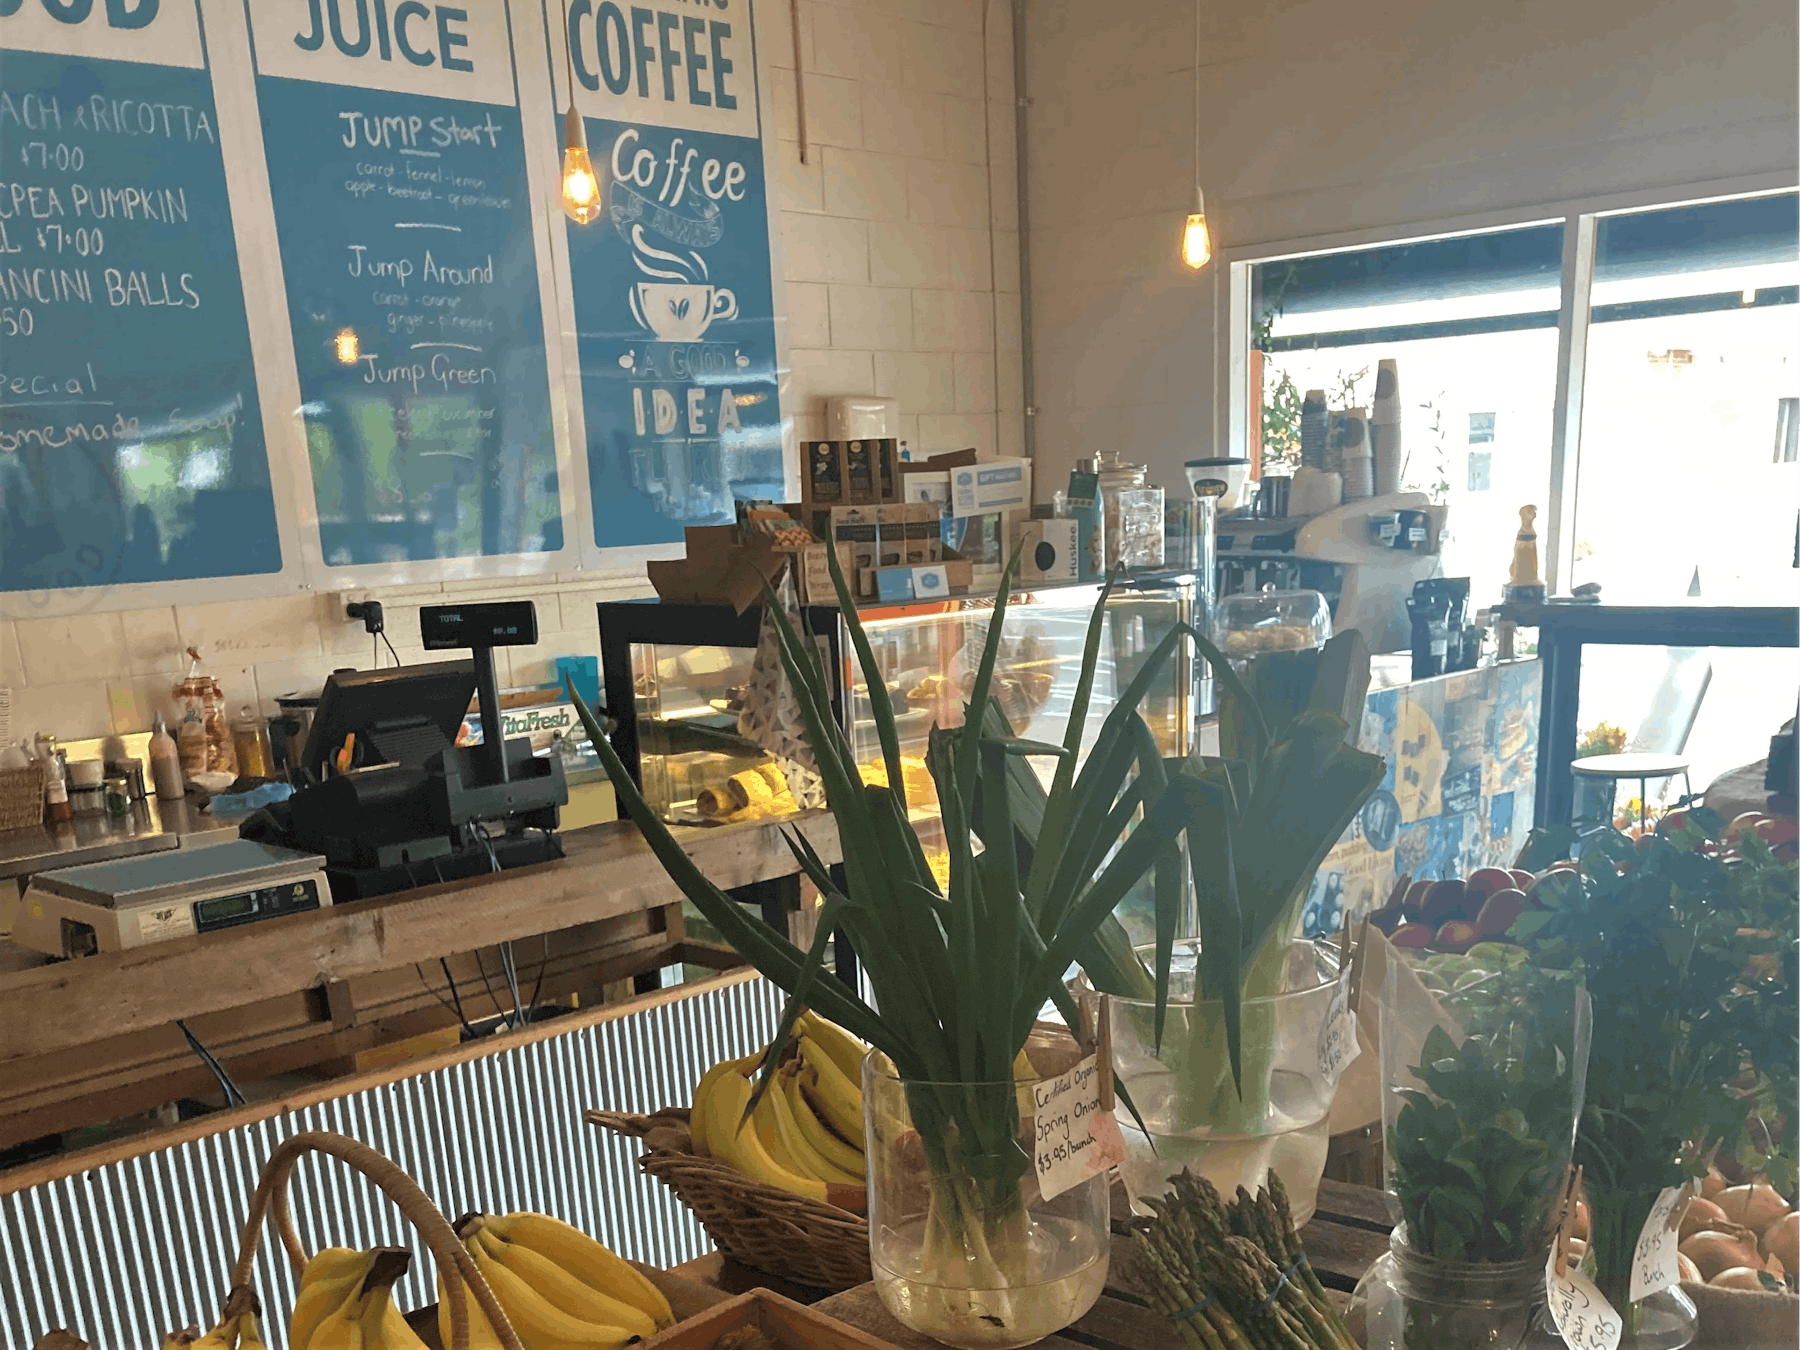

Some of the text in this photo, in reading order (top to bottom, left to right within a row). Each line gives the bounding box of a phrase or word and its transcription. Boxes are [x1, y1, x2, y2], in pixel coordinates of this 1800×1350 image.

[293, 0, 474, 73] JUICE
[568, 0, 738, 111] COFFEE
[90, 94, 214, 143] RICOTTA
[338, 111, 502, 149] JUMP Start
[611, 128, 747, 207] Coffee
[71, 184, 188, 224] PUMPKIN
[104, 267, 200, 309] BALLS
[347, 245, 494, 288] Jump Around
[359, 352, 497, 396] Jump Green
[1069, 526, 1077, 577] Huskee
[1035, 1062, 1100, 1109] Certified Organic
[1036, 1114, 1070, 1144] Spring
